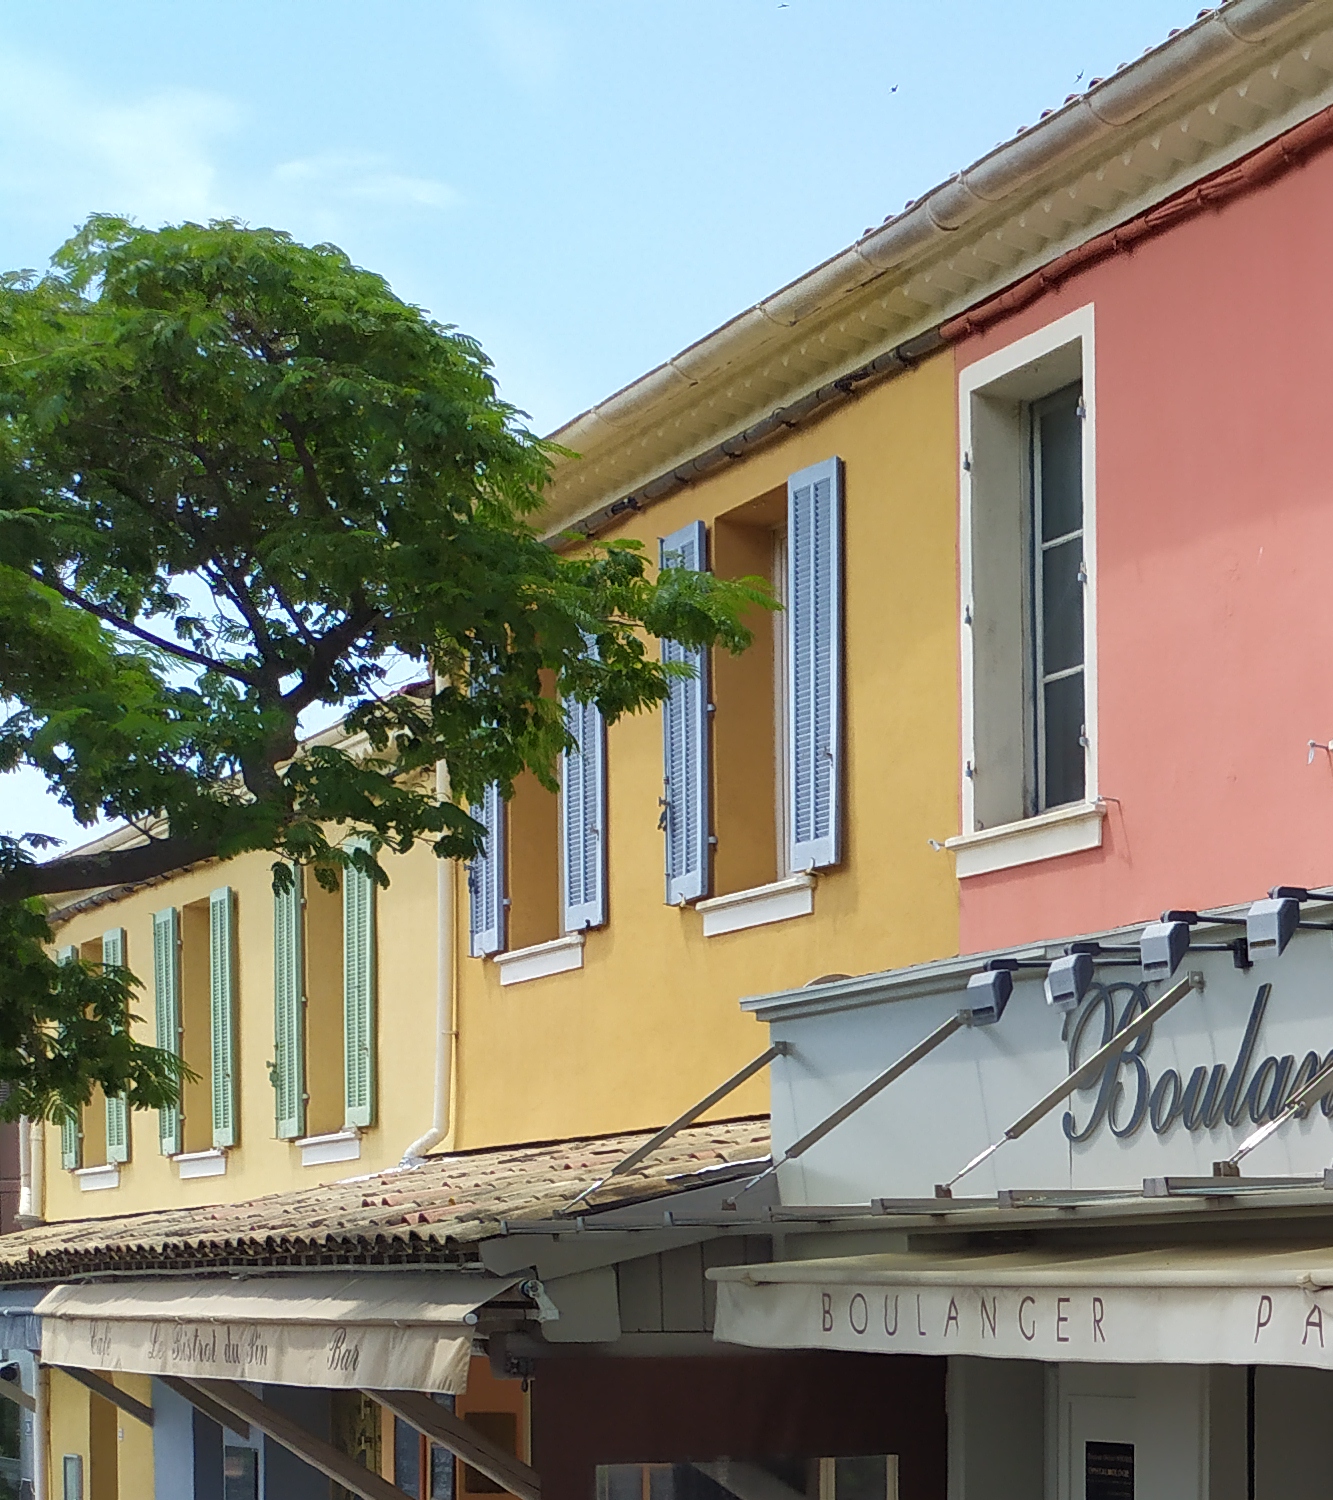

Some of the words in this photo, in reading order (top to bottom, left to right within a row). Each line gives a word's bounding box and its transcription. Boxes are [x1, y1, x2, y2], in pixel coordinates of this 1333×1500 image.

[822, 1292, 1106, 1344] BOULANGER
[224, 1325, 241, 1365] du
[327, 1326, 361, 1372] Bar
